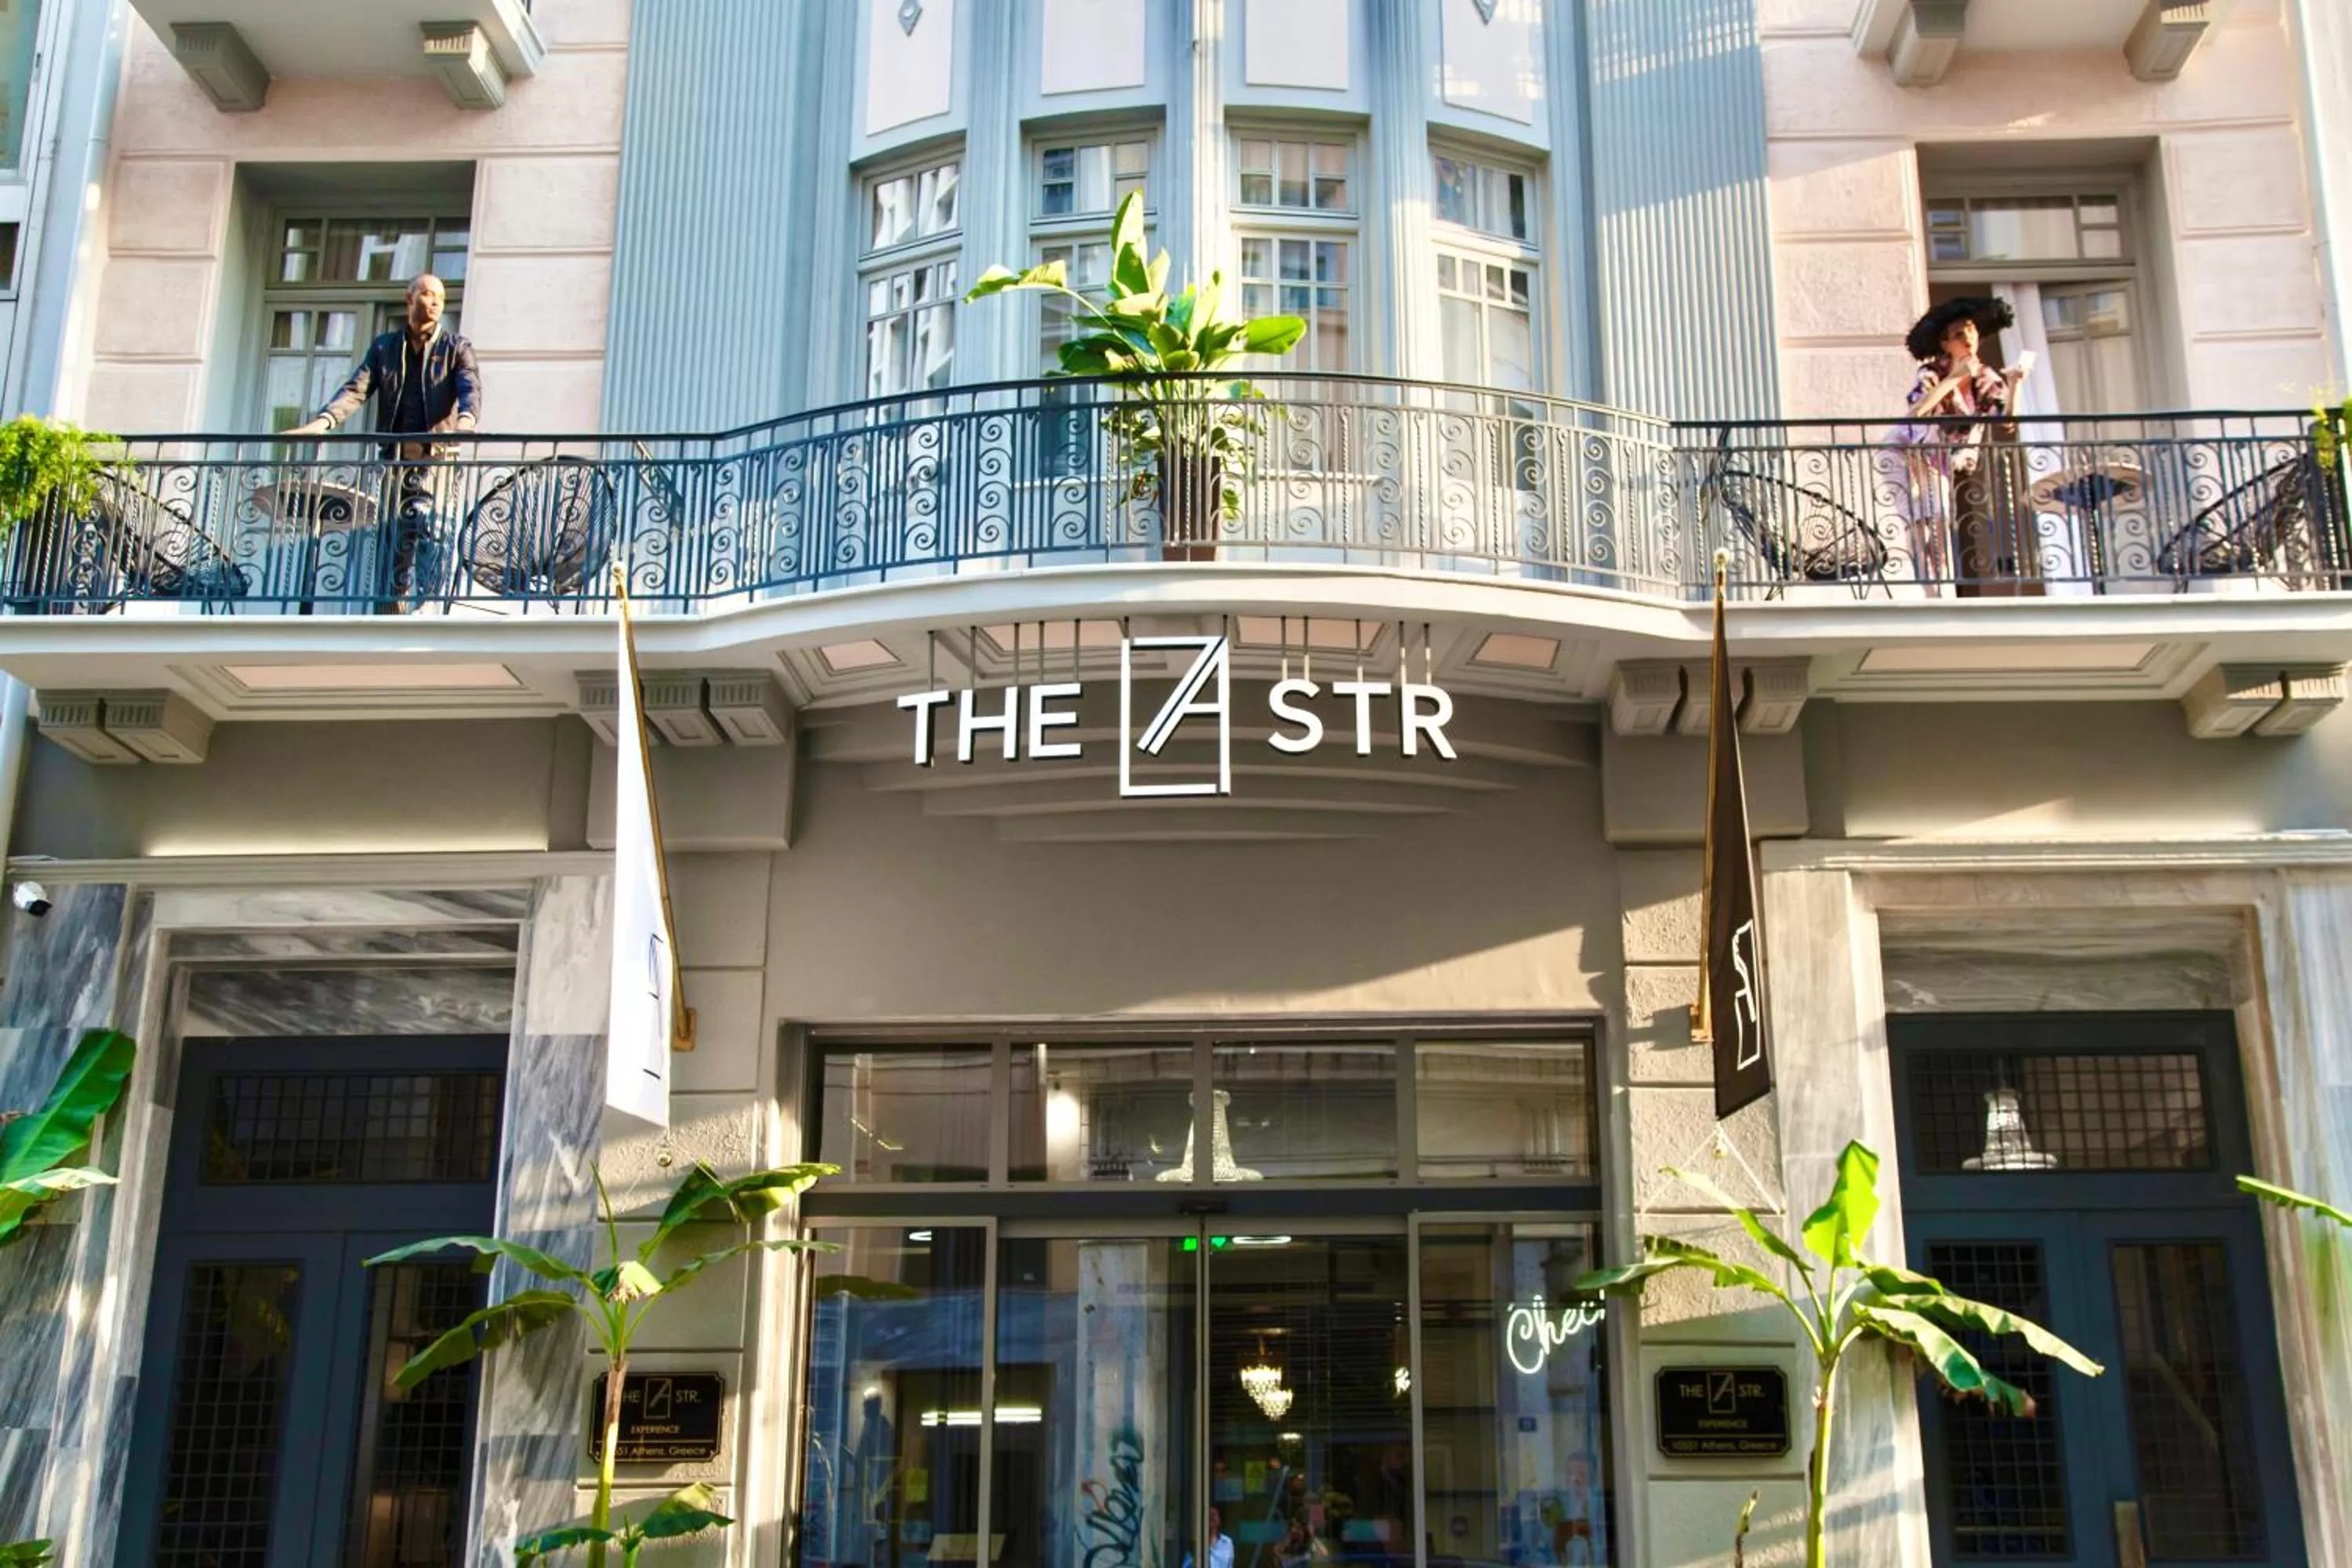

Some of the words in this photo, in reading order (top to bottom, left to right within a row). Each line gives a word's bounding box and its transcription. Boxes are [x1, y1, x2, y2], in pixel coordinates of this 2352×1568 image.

[897, 684, 1082, 766] THE
[1267, 679, 1457, 759] STR
[1679, 1384, 1704, 1399] THE
